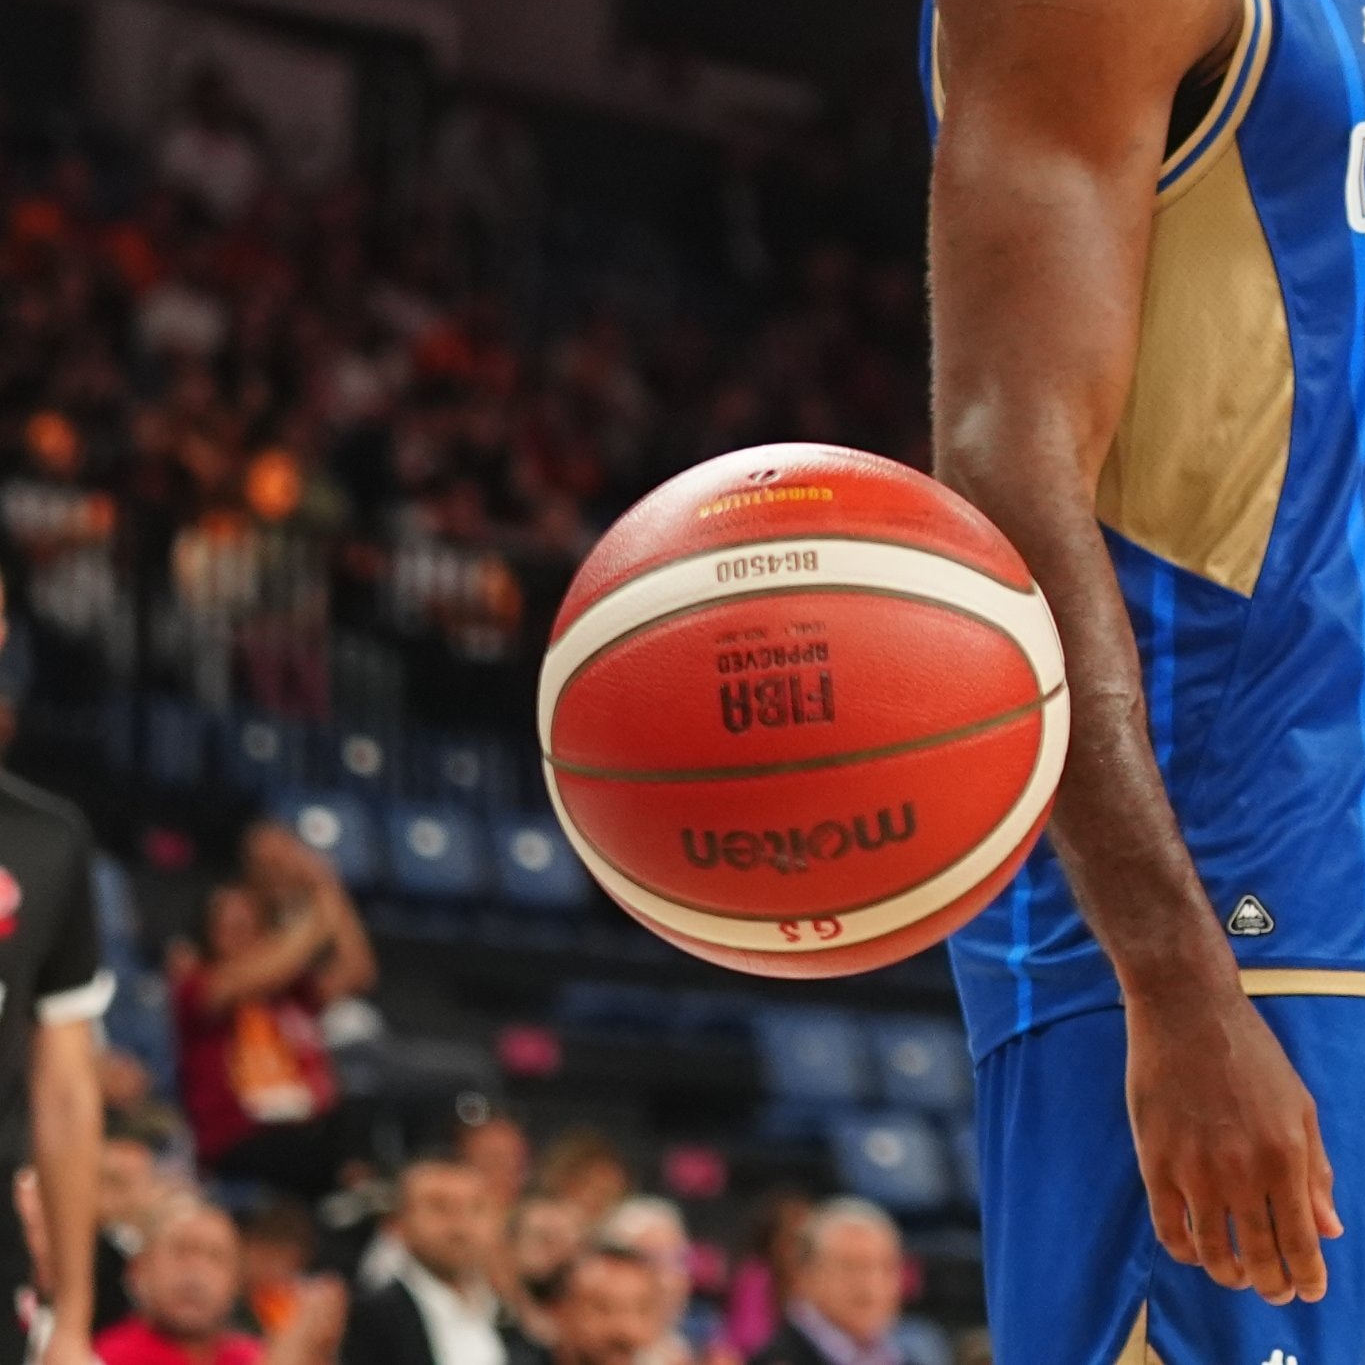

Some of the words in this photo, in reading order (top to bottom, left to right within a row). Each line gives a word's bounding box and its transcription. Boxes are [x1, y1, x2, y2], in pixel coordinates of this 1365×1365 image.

[716, 550, 820, 583] BG4500
[719, 669, 837, 736] FIBA
[682, 799, 918, 874] molten
